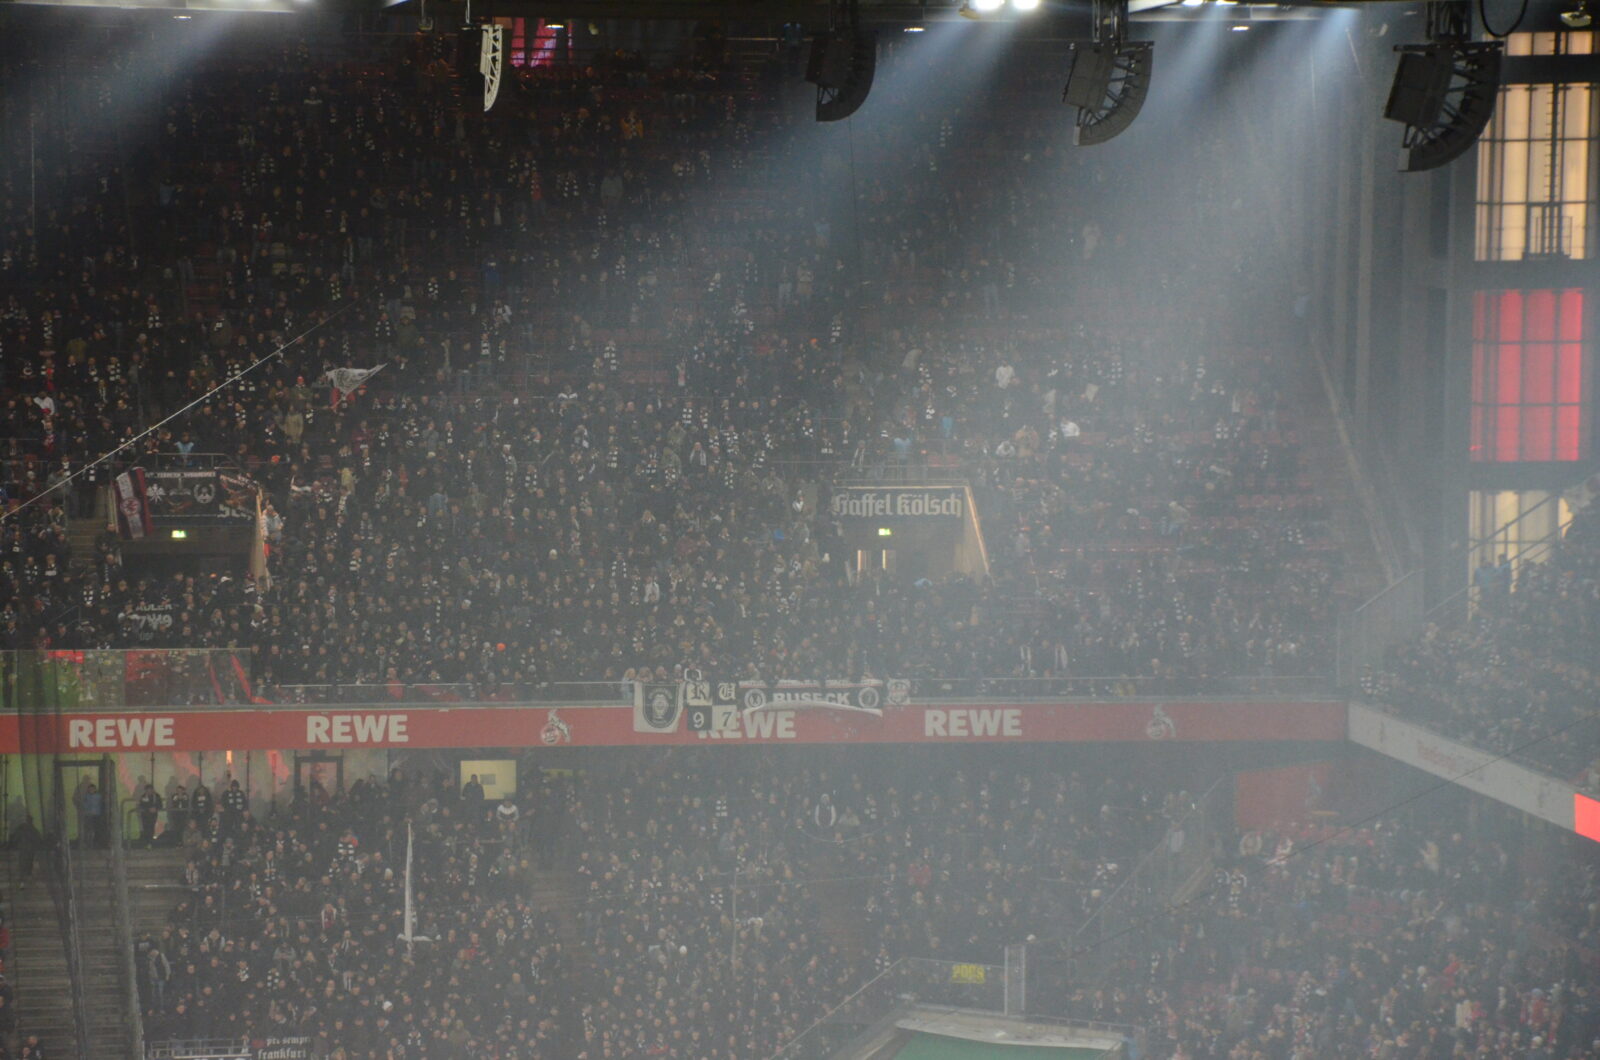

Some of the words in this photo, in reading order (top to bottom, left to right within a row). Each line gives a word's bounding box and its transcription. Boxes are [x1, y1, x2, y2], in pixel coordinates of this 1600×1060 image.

[897, 493, 963, 518] Kölsch
[68, 718, 175, 748] REWE
[306, 714, 409, 744] REWE
[698, 711, 796, 739] EWE
[924, 709, 1022, 737] REWE
